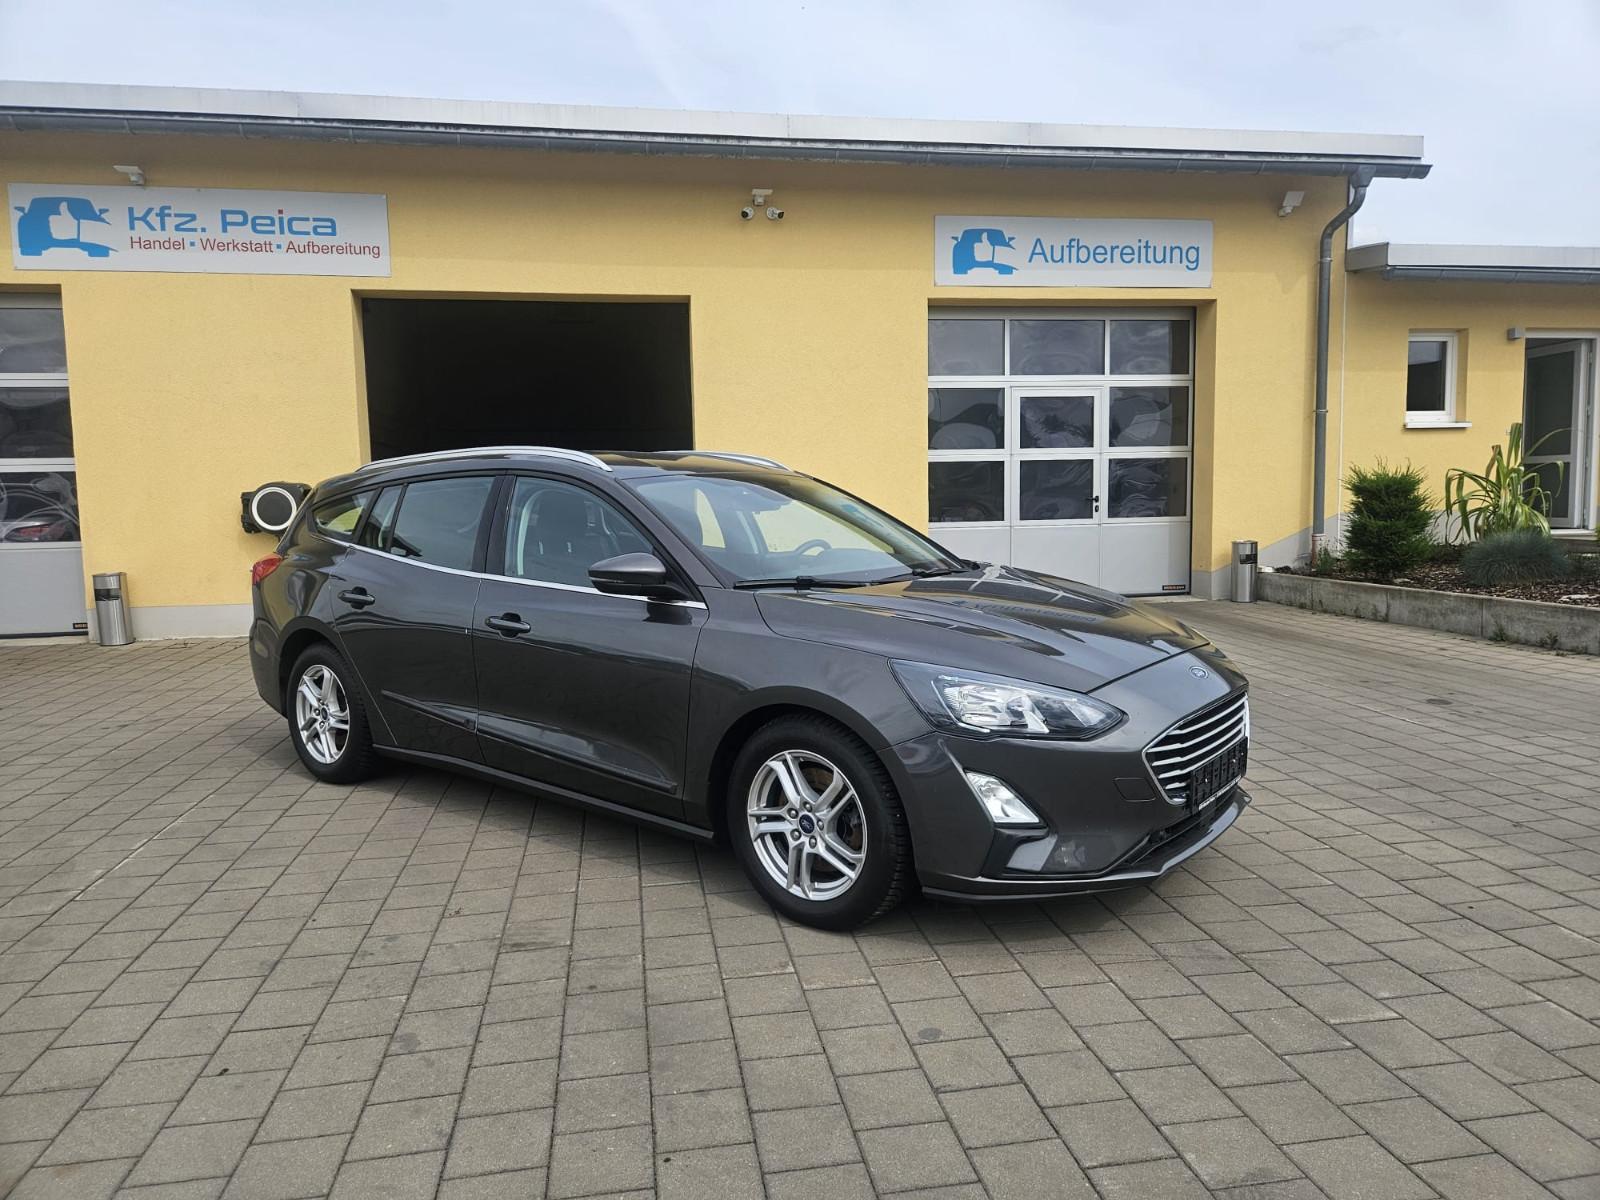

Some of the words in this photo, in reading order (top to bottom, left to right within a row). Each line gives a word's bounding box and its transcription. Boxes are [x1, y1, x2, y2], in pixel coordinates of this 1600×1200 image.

[128, 206, 206, 232] Kfz.
[221, 209, 337, 237] Peica
[130, 236, 185, 251] Handel
[200, 238, 273, 253] Werkstatt
[286, 240, 380, 258] Aufbereitung
[1028, 238, 1200, 271] Aufbereitung
